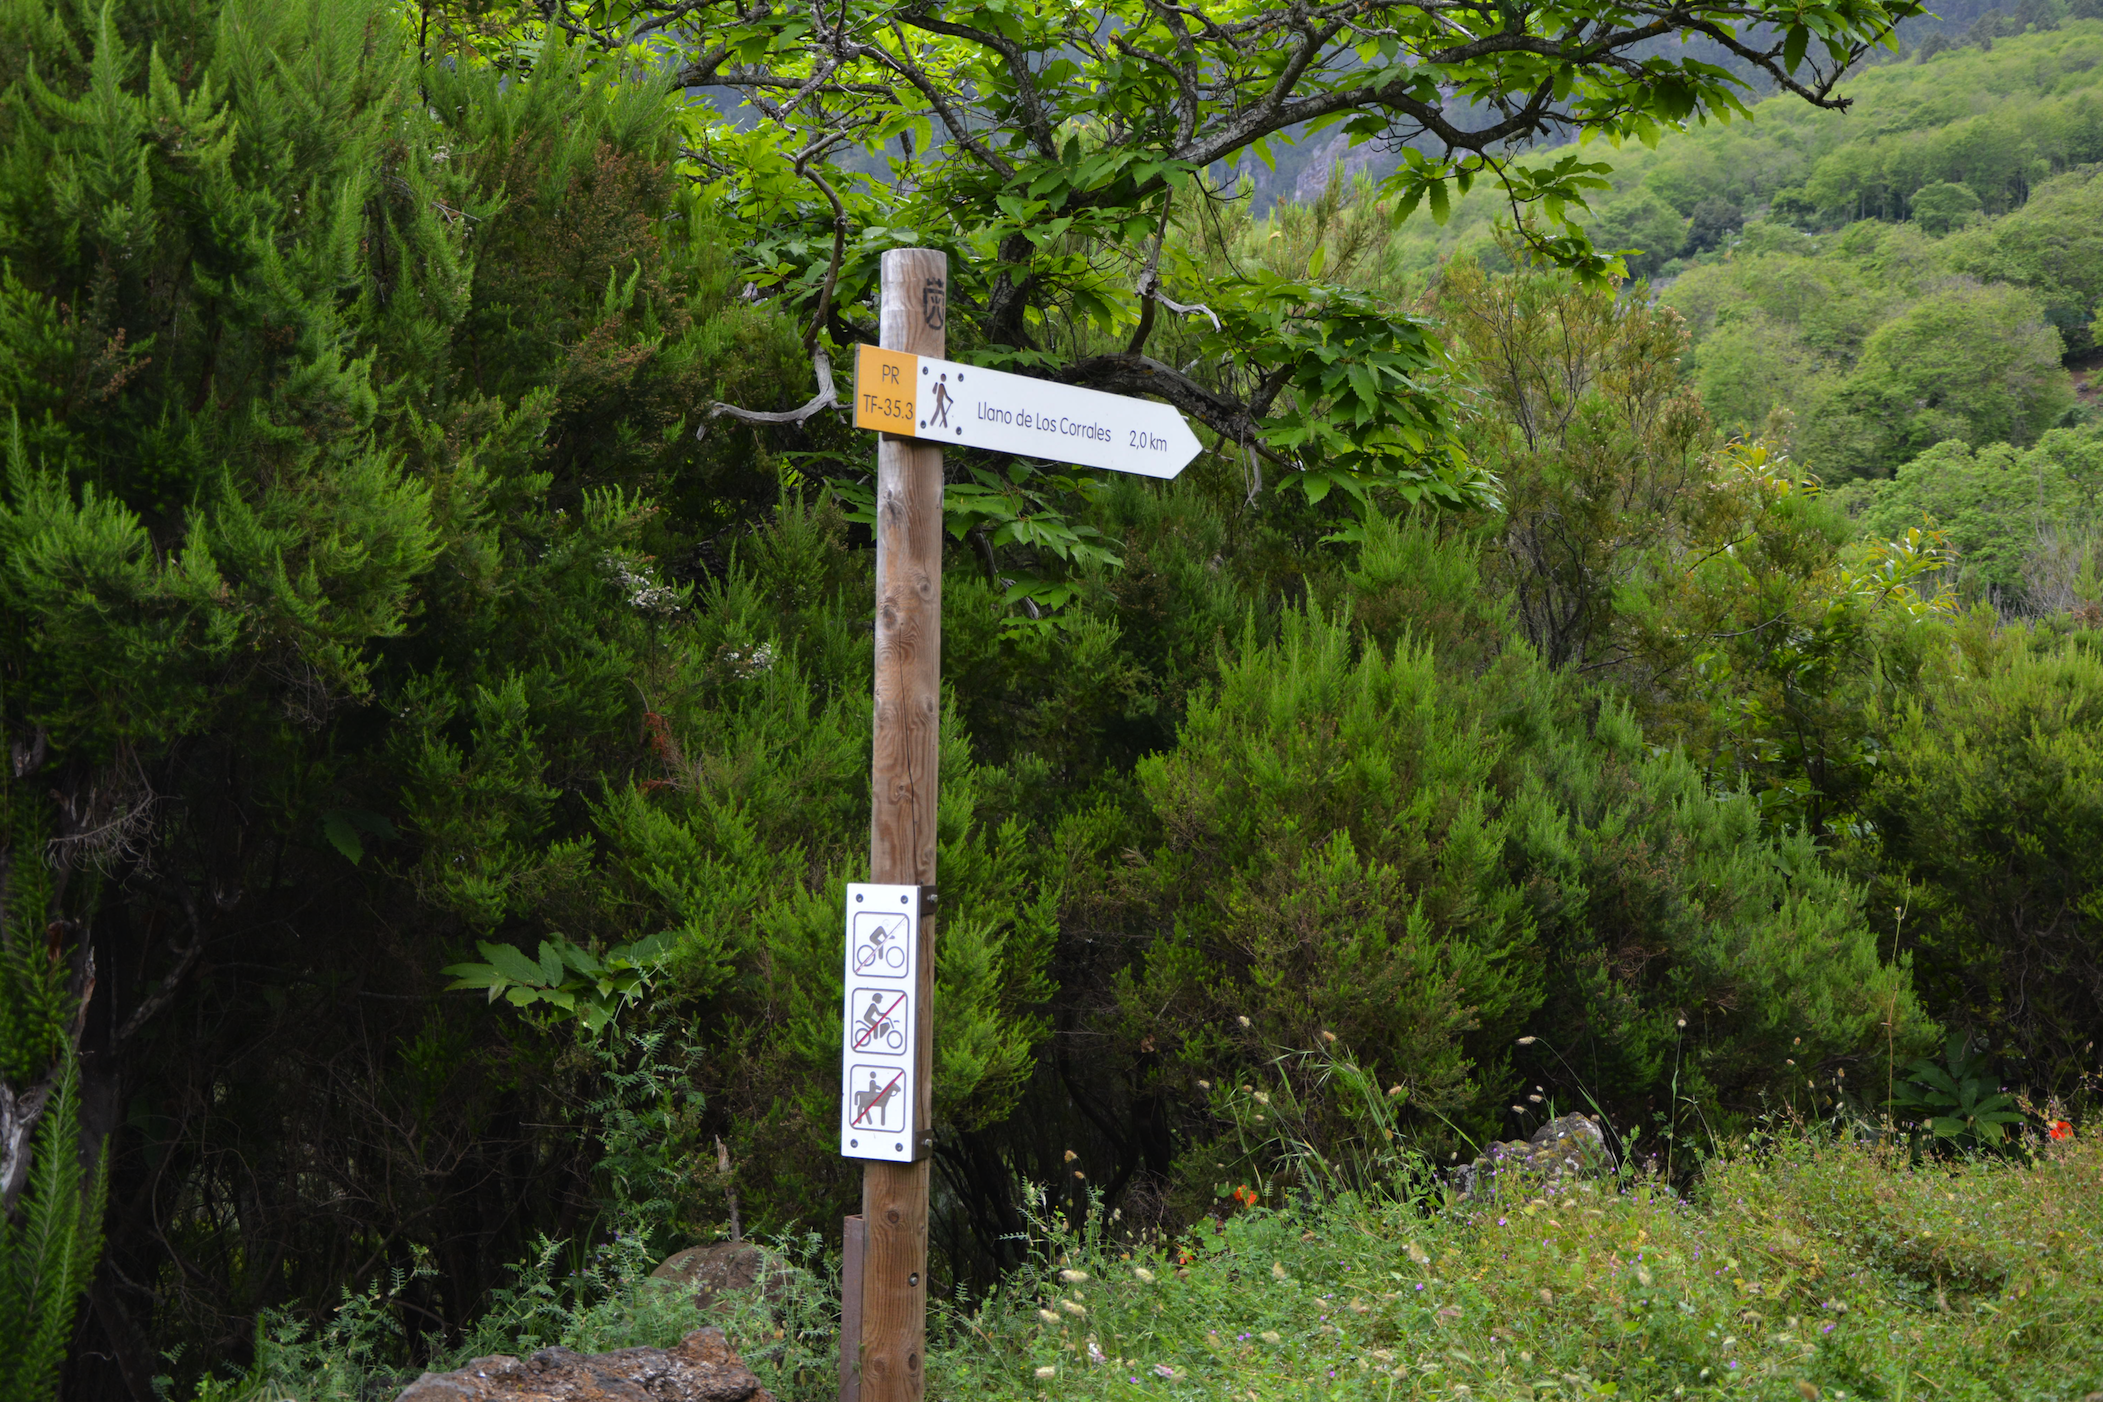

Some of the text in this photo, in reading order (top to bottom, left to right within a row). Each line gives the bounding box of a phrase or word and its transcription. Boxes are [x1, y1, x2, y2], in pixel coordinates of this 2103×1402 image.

[881, 364, 900, 385] PR
[863, 394, 914, 420] TF-35.3
[978, 401, 1168, 452] Llano de Los Corrales 2,0 km
